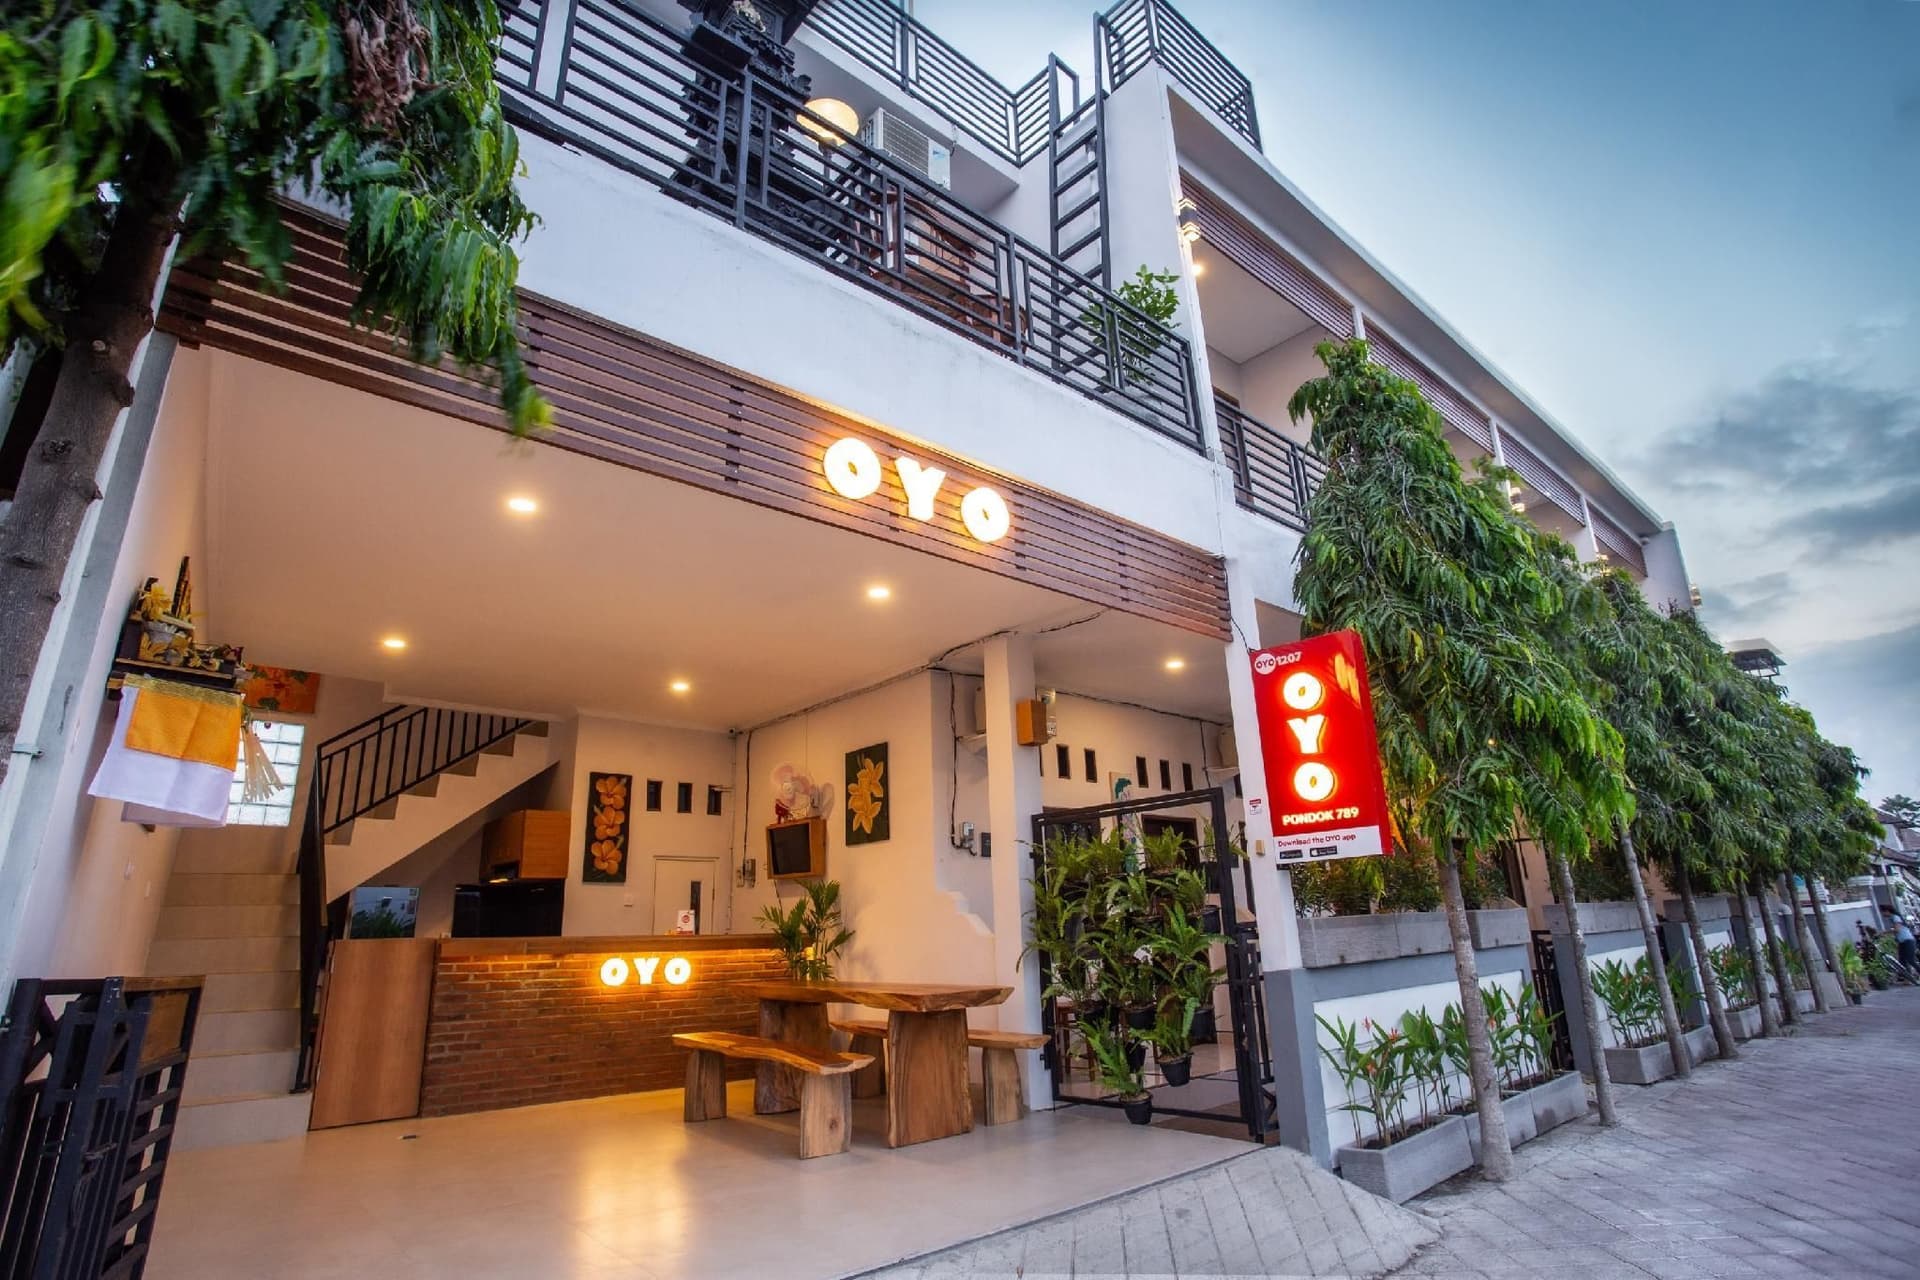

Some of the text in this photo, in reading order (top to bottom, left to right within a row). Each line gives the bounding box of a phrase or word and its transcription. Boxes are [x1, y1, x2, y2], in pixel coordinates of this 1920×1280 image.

[823, 437, 1010, 543] OYO
[1255, 651, 1303, 669] OYO 1207
[1283, 672, 1338, 801] OYO
[1282, 806, 1359, 825] PONDOK 789
[1278, 838, 1312, 848] Download
[1325, 834, 1341, 842] OYO
[600, 957, 691, 987] OYO
